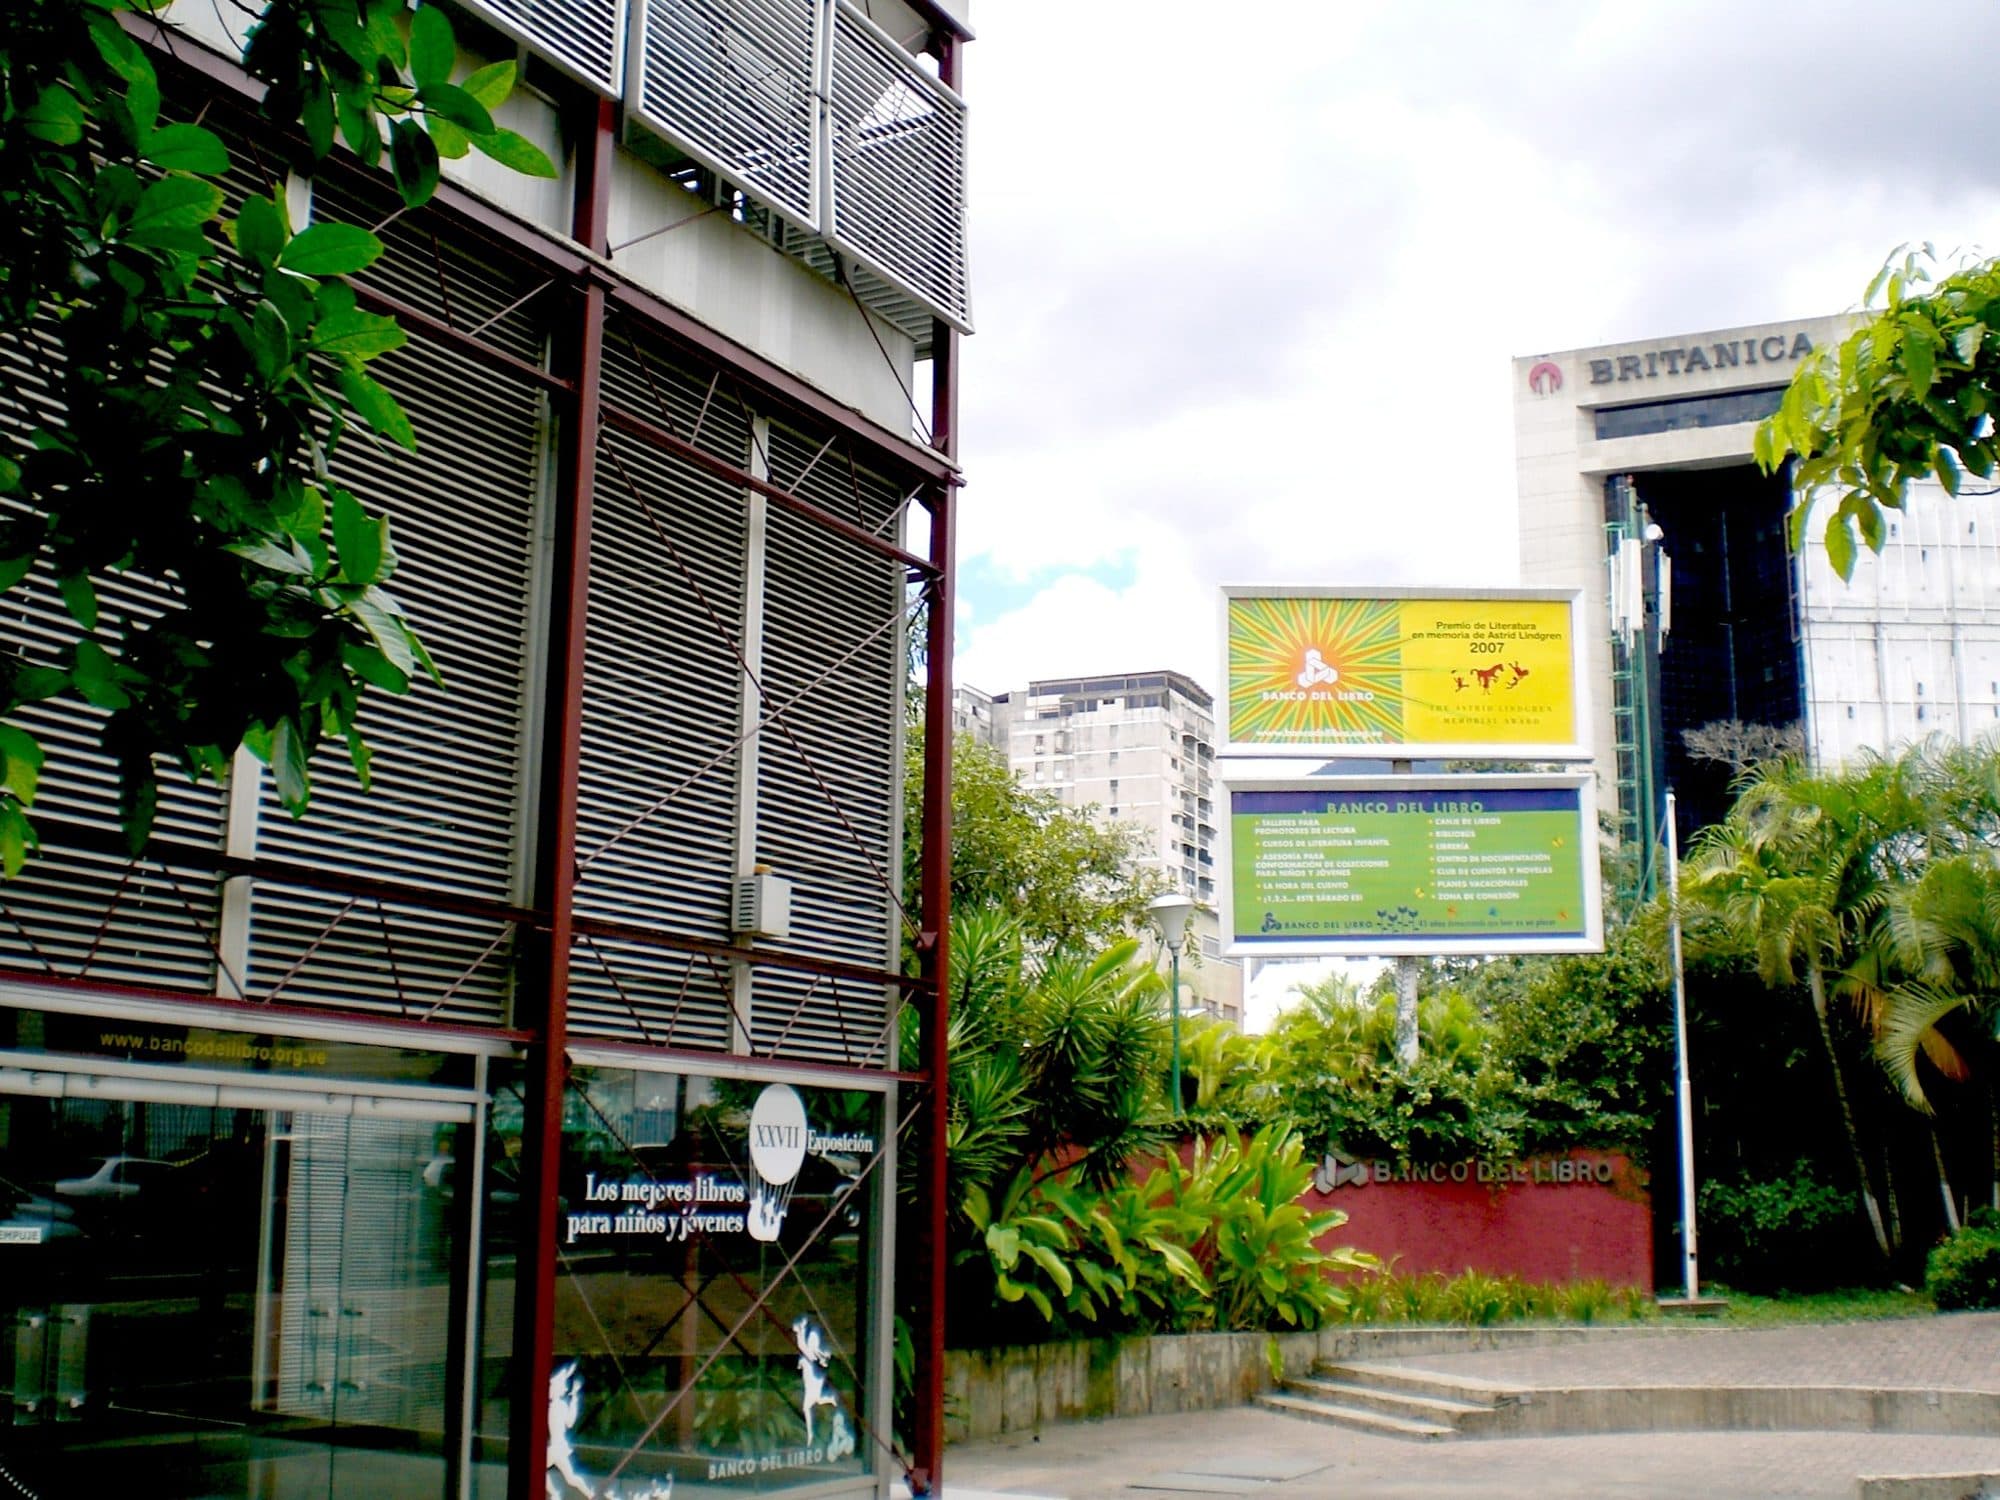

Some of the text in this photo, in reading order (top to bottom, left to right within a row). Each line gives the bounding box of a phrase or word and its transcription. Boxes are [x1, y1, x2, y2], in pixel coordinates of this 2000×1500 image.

[1589, 332, 1813, 384] BRITANICA
[1436, 621, 1536, 630] Premio de Literatura
[1473, 631, 1485, 639] de
[1488, 631, 1515, 639] Astrid
[1519, 631, 1562, 641] Lindgren
[1470, 642, 1504, 653] 2007
[1262, 691, 1374, 701] BANCO DEL LIBRO
[1456, 704, 1495, 712] ASTRID
[1327, 802, 1484, 814] BANCO DEL LIBRO
[1262, 819, 1297, 827] TALLERES
[1474, 817, 1501, 825] LIBROS
[1255, 827, 1309, 835] PROMOTORES
[1323, 826, 1356, 834] LECTURA
[1262, 840, 1294, 848] CURSOS
[1308, 839, 1353, 847] LITERATURA
[1355, 838, 1390, 847] INFANTIL
[1436, 842, 1470, 850] LIBRERÍA
[1262, 852, 1325, 860] ASESORÍA PARA
[1437, 855, 1468, 863] CENTRO
[1482, 853, 1551, 862] DOCUMENTACIÓN
[1255, 860, 1322, 869] CONFORMACIÓN
[1337, 860, 1389, 868] COLECCIONES
[1256, 869, 1277, 877] PARA
[1279, 868, 1306, 877] NIÑOS
[1316, 868, 1351, 877] JÓVENES
[1437, 868, 1456, 876] CLUB
[1471, 867, 1506, 875] CUENTOS
[1517, 866, 1553, 874] NOVELAS
[1263, 882, 1273, 890] LA
[1275, 882, 1299, 890] HORA
[1437, 879, 1528, 888] PLANES VACACIONALES
[1438, 893, 1462, 901] ZONA
[1284, 920, 1373, 930] BANCO DEL LIBRO
[100, 1032, 328, 1067] www.bancodellibro.org.ve
[755, 1124, 874, 1153] XXVII Exposición
[1374, 1160, 1612, 1183] BANCO DEL LIBRO
[585, 1173, 745, 1210] Los mejores libros
[566, 1208, 744, 1243] para niños y jóvenes
[708, 1449, 822, 1480] BANCO DEL LIBRO
